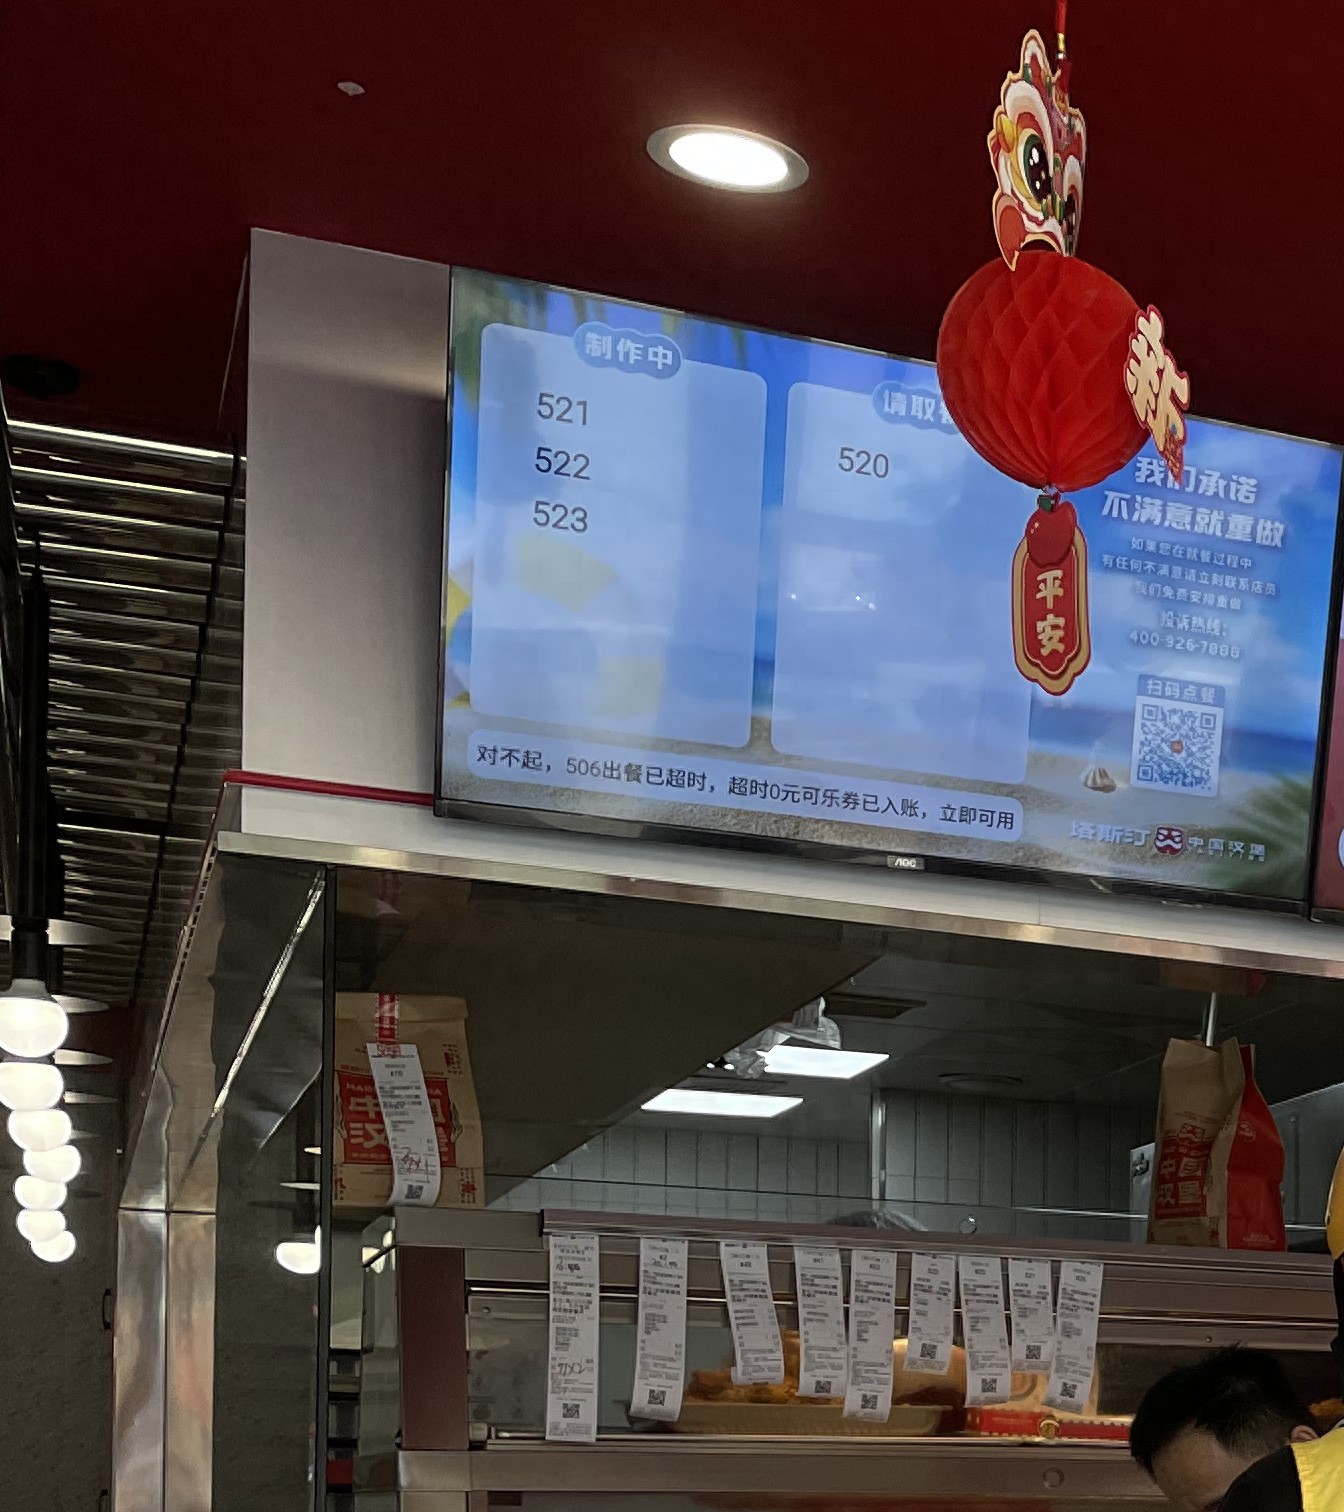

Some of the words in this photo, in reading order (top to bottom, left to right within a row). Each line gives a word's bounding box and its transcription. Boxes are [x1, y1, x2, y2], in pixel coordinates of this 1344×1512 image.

[583, 330, 674, 371] 制作中
[536, 392, 590, 427] 521
[534, 446, 592, 480] 522
[837, 446, 890, 479] 520
[531, 500, 589, 534] 523
[1101, 491, 1286, 549] 不满意就重做
[1035, 570, 1066, 657] 平安
[1145, 677, 1217, 705] 扫码点餐
